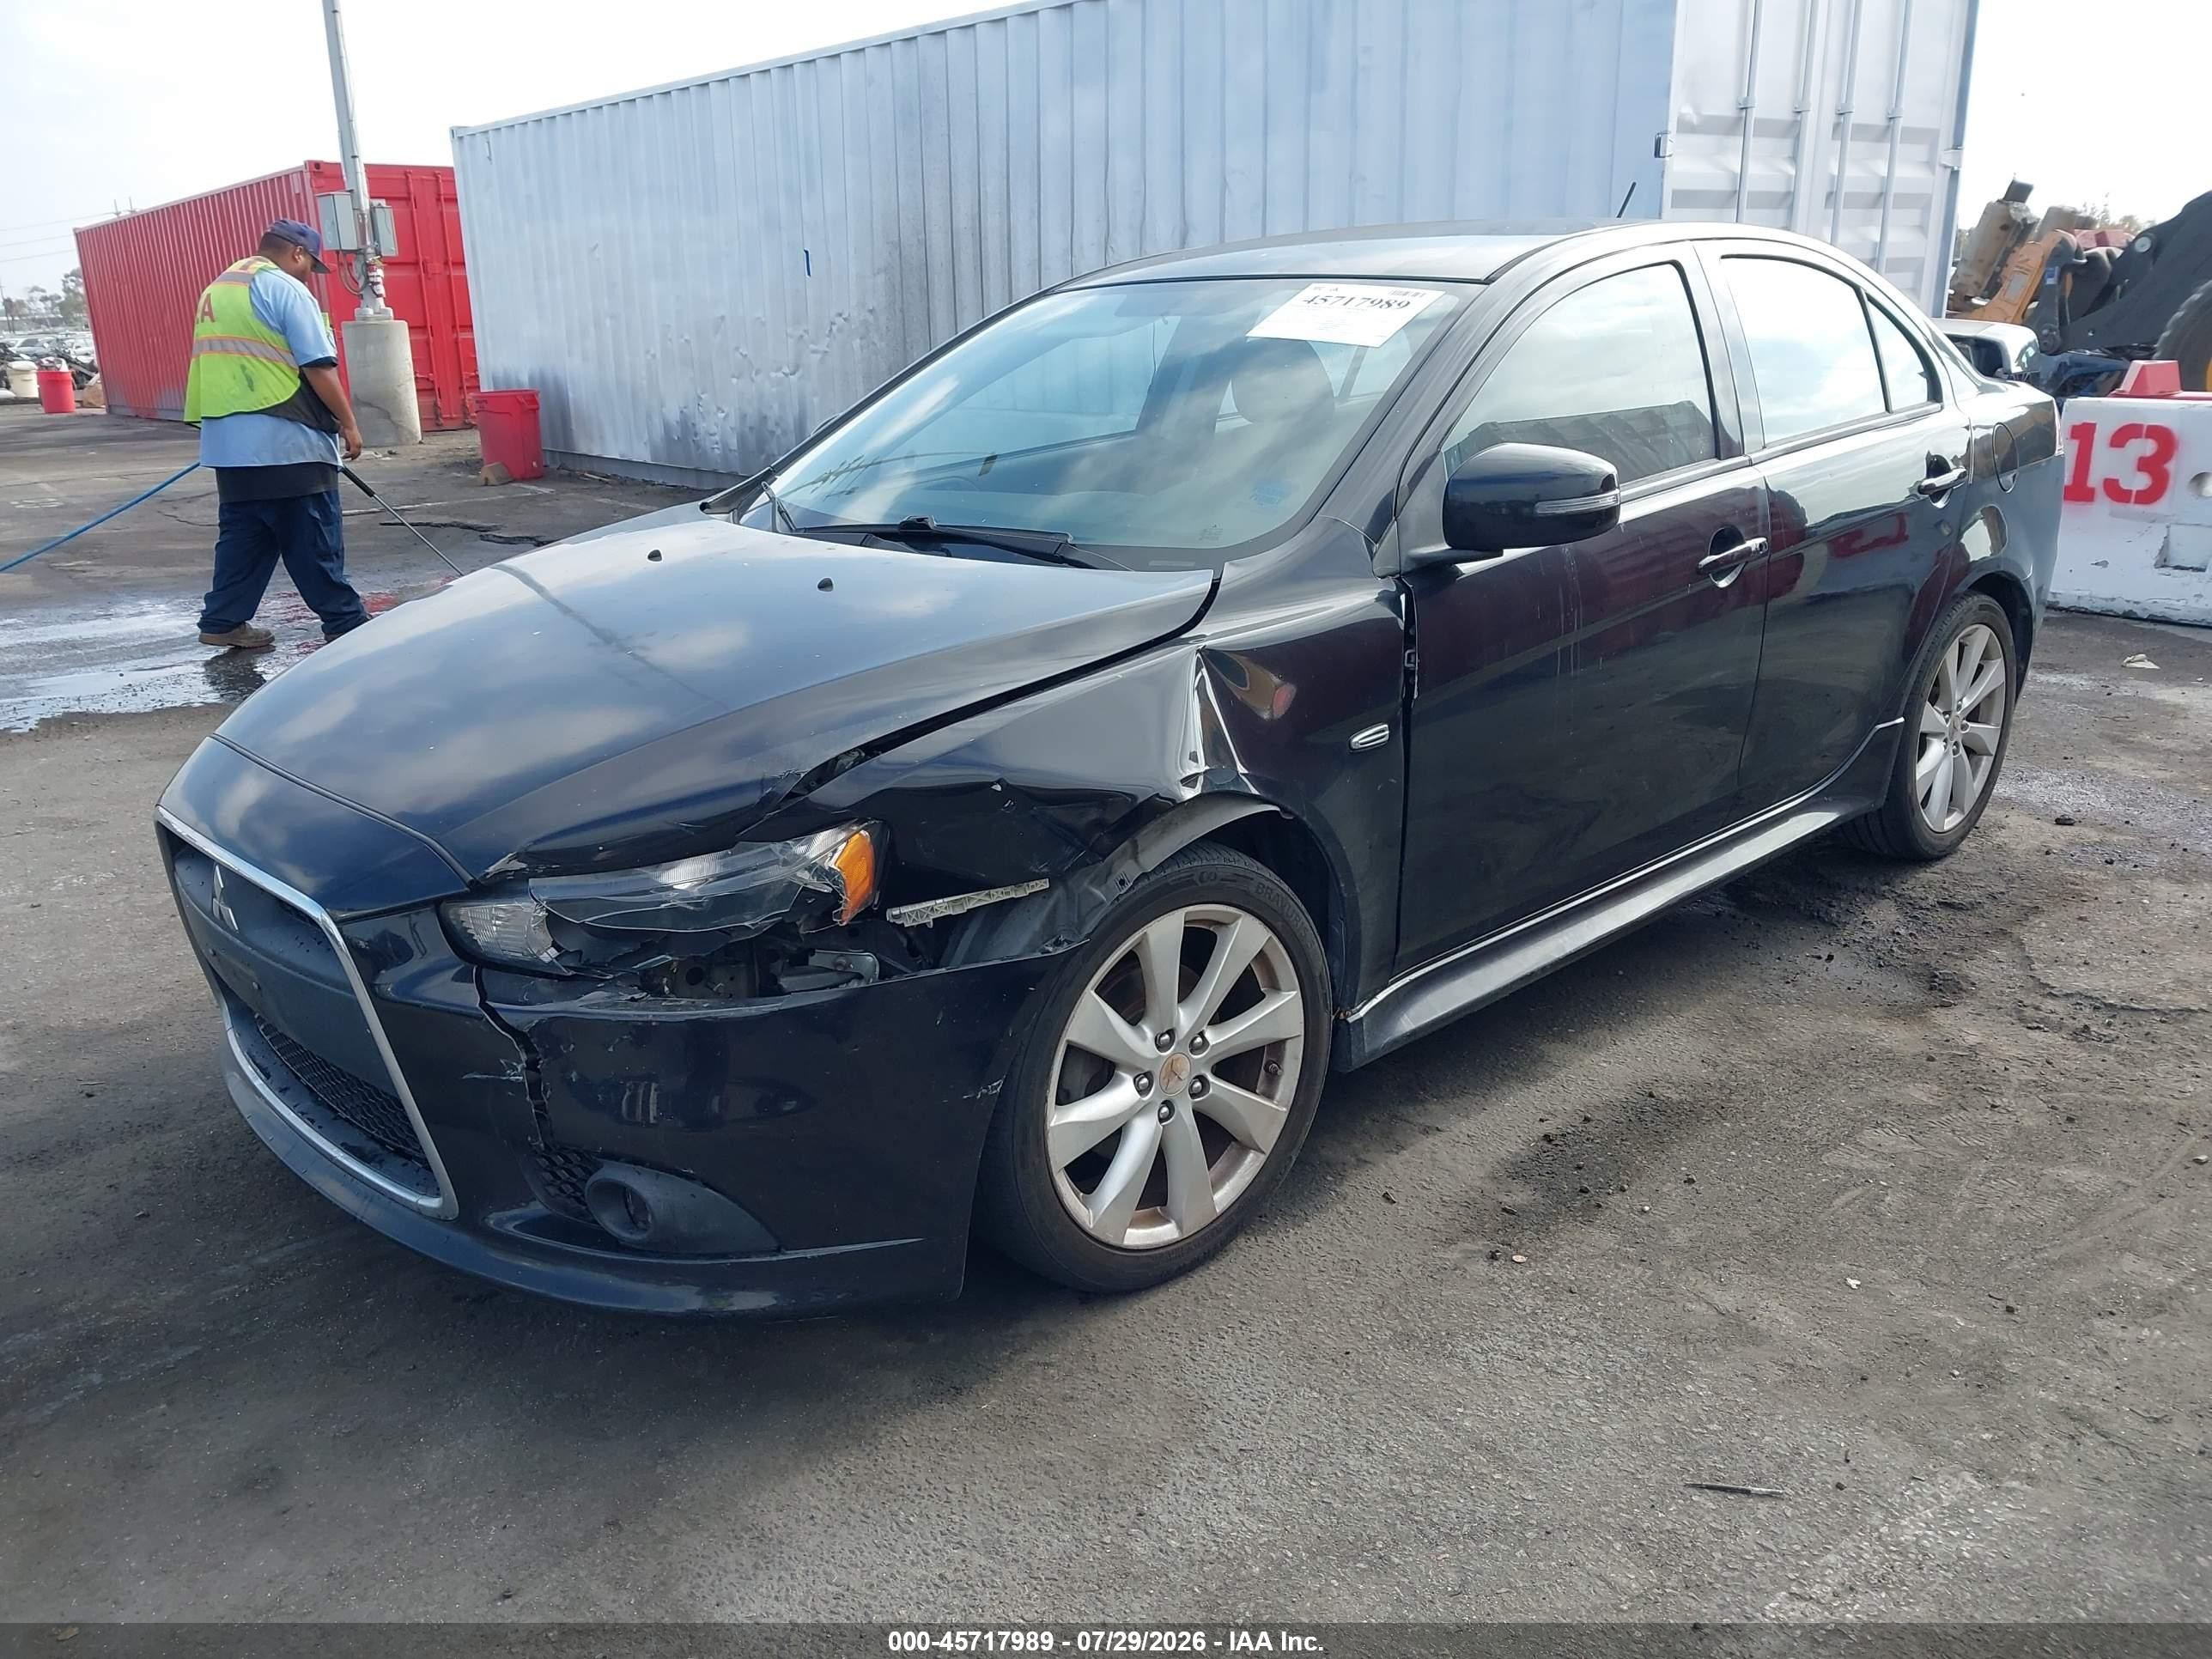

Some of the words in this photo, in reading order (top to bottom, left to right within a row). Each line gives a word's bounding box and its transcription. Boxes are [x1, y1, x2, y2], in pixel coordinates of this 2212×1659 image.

[196, 293, 216, 324] A
[1302, 295, 1411, 310] 45717989
[2063, 422, 2178, 505] 13
